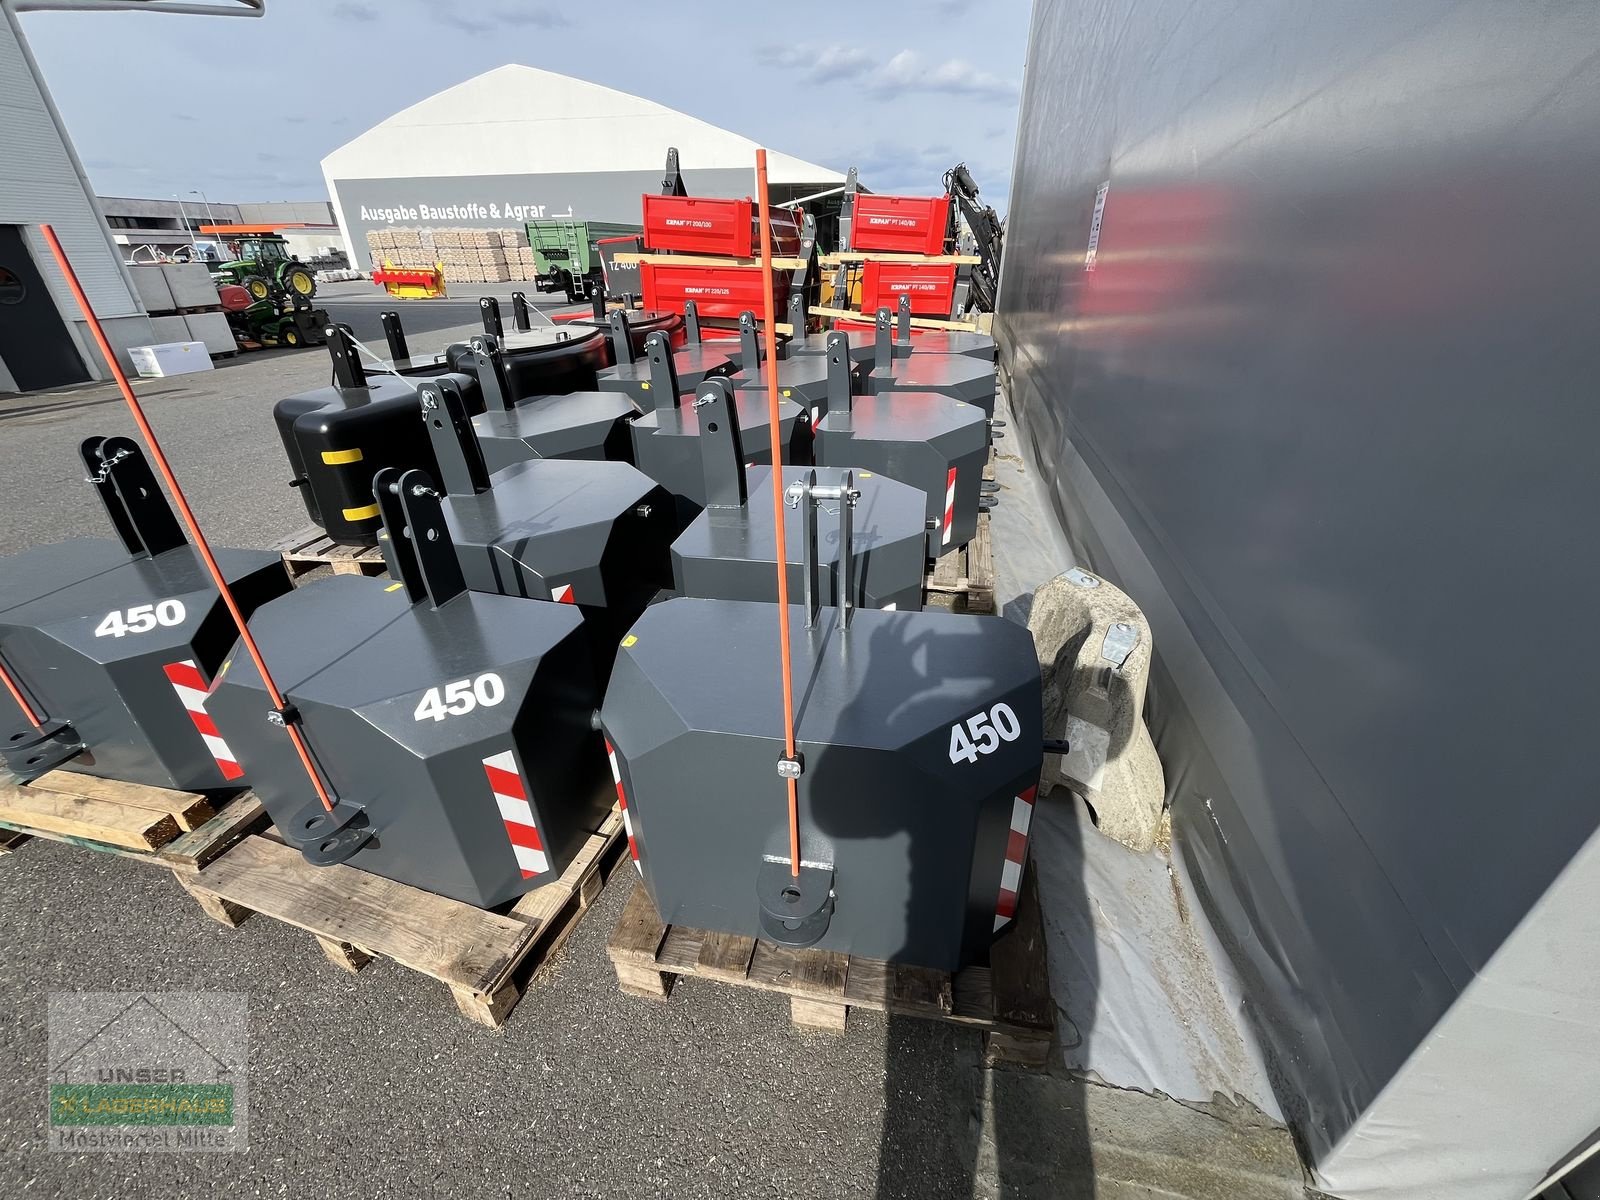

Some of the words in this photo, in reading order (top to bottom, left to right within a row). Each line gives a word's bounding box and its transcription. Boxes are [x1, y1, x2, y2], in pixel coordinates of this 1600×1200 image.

[361, 205, 418, 223] Ausgabe
[419, 203, 487, 220] Baustoffe
[489, 203, 501, 219] &
[504, 202, 546, 222] Agrar
[95, 599, 186, 638] 450
[413, 672, 505, 722] 450
[948, 702, 1021, 764] 450
